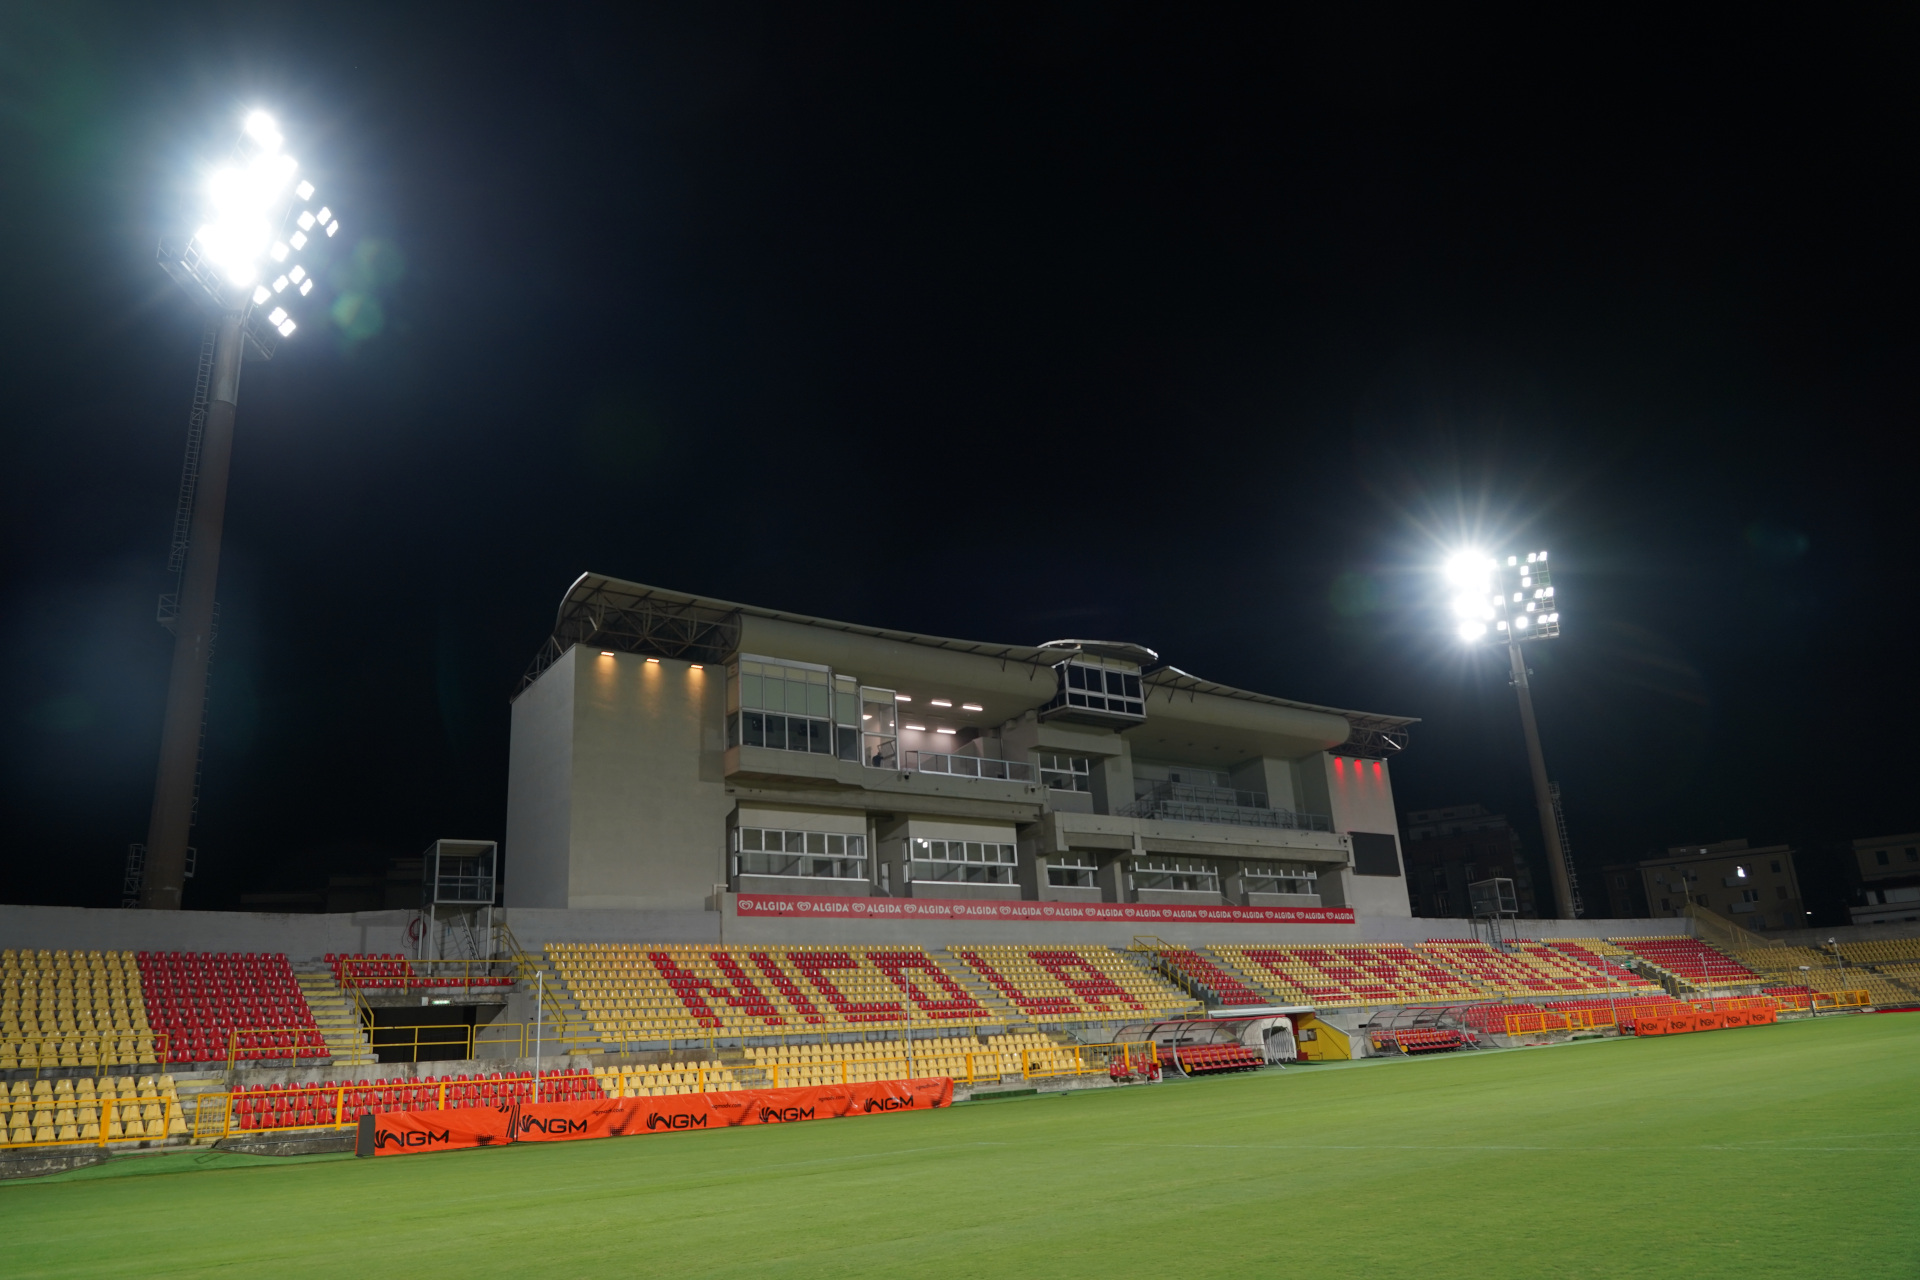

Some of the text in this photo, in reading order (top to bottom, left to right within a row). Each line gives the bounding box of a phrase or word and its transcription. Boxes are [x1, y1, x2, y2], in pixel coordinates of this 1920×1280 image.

[755, 901, 793, 911] ALGIDA
[812, 903, 849, 912] ALGIDA
[867, 904, 900, 913] ALGIDA
[918, 905, 950, 914] ALGIDA
[966, 905, 997, 915] ALGIDA
[1012, 906, 1041, 915] ALGIDA
[1055, 907, 1083, 916] ALGIDA
[1097, 908, 1123, 917] ALGIDA
[1136, 909, 1161, 917] ALGIDA
[1173, 910, 1197, 918] ALGIDA
[1208, 911, 1231, 919] ALGIDA
[1242, 911, 1264, 919] ALGIDA
[1305, 912, 1325, 920] ALGIDA
[1334, 912, 1353, 920] ALGIDA
[648, 951, 1145, 1028] NICOLA
[863, 1094, 914, 1113] NGM
[519, 1114, 587, 1134] NGM
[646, 1112, 707, 1130] NGM
[759, 1106, 814, 1123] NGM
[375, 1129, 450, 1148] NGM
